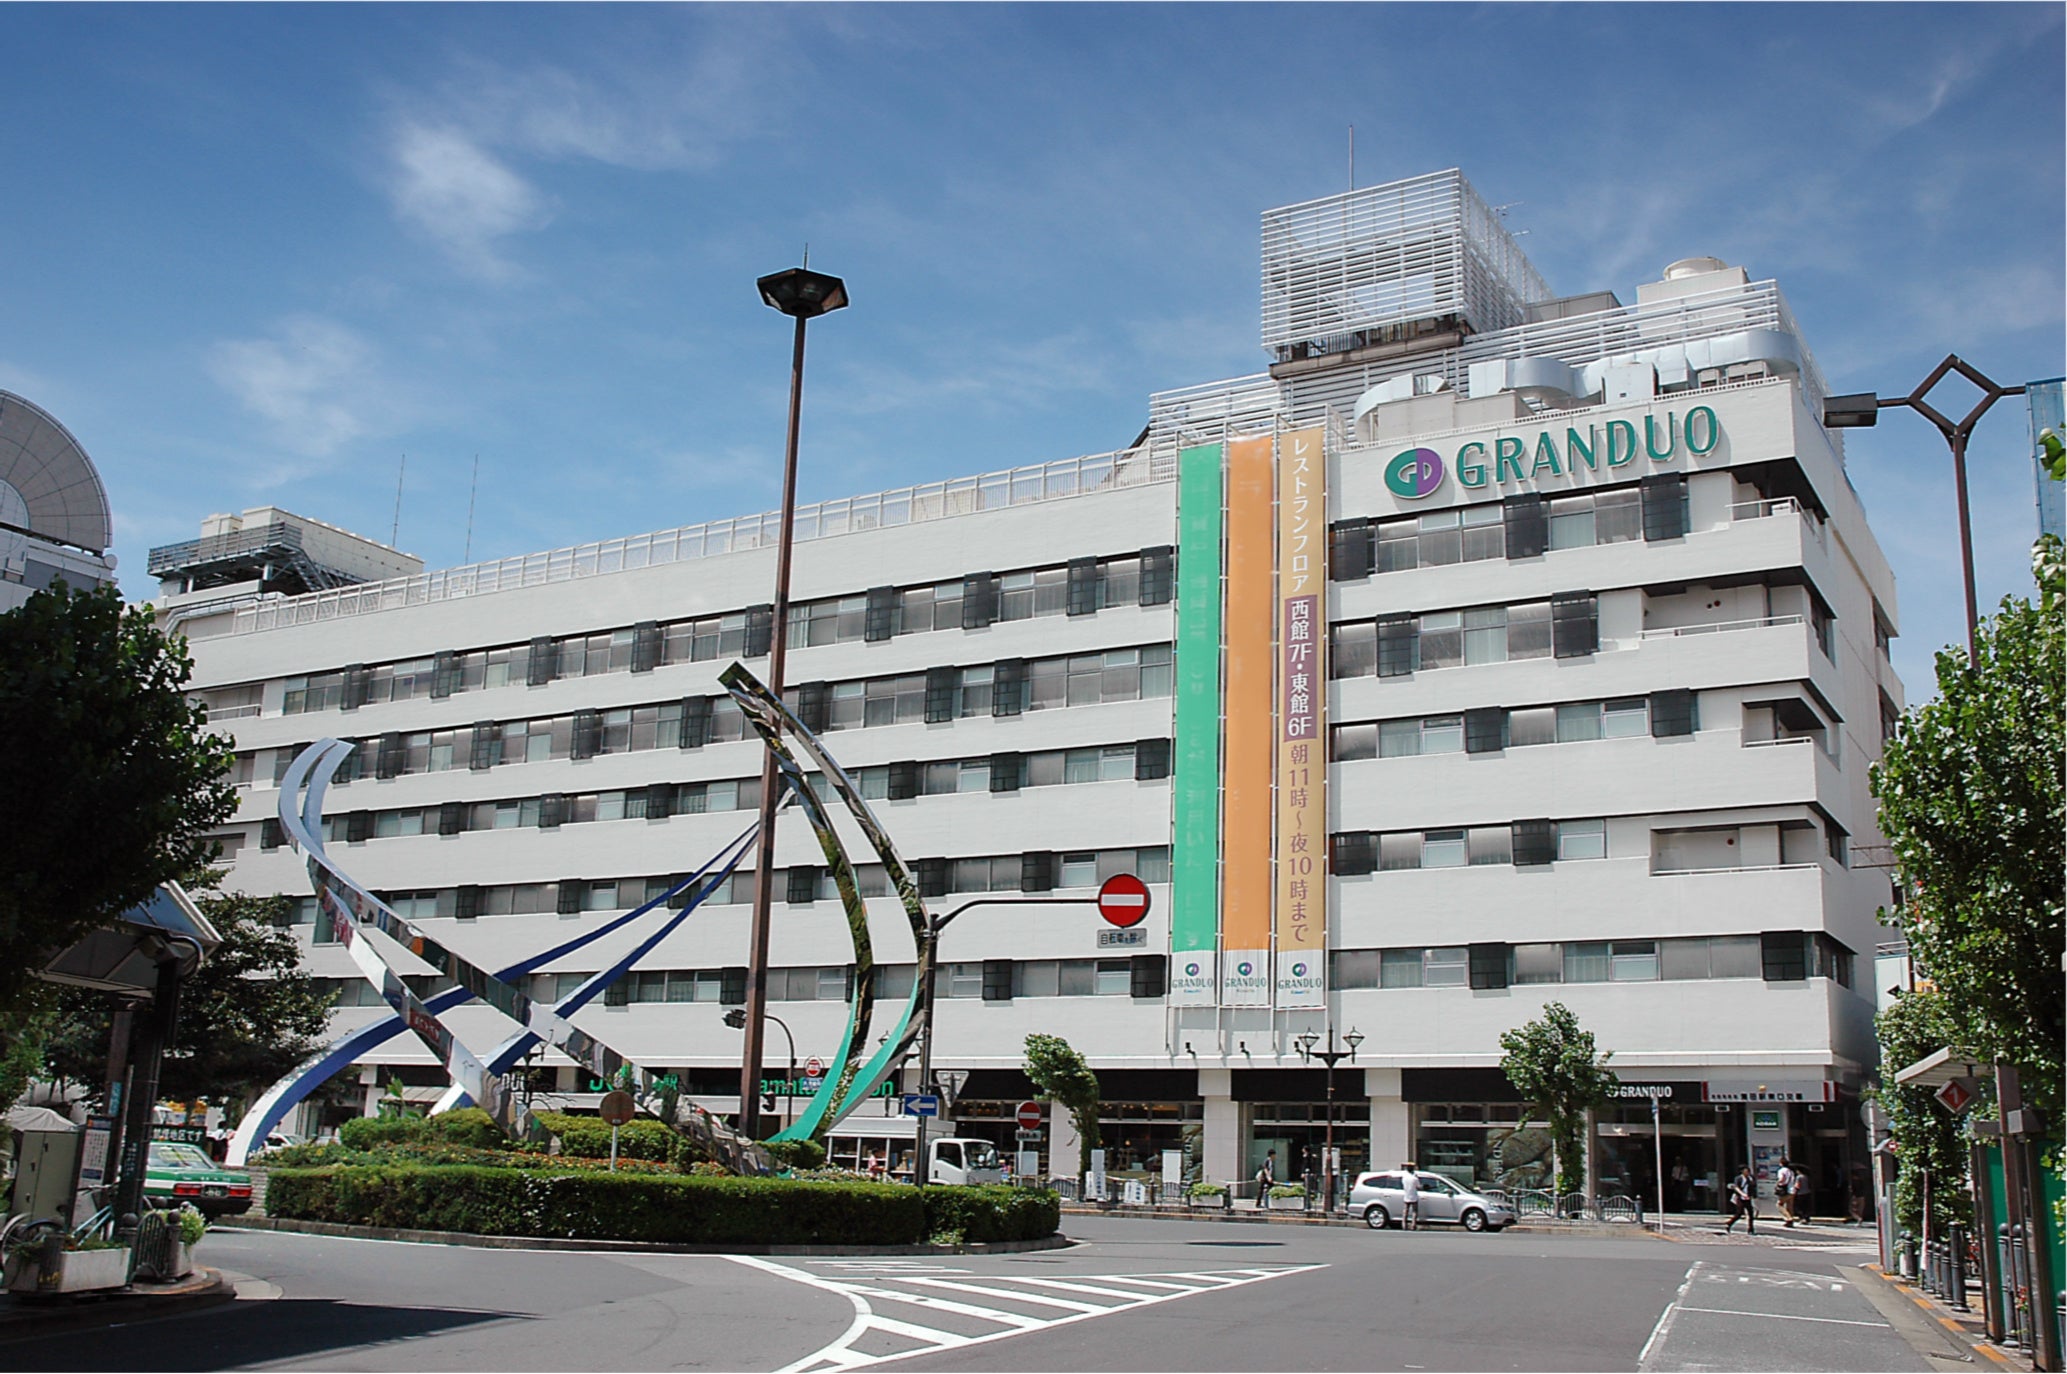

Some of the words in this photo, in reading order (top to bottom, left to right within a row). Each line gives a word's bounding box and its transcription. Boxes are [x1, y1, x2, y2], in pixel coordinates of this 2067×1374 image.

[1456, 405, 1719, 488] GRANDUO
[1292, 438, 1310, 593] レストランフロア
[1288, 600, 1312, 736] 西館7F・東館6F
[1225, 977, 1266, 988] GRANDUO
[1620, 1086, 1672, 1098] GRANDUO
[1949, 1087, 1959, 1104] 1
